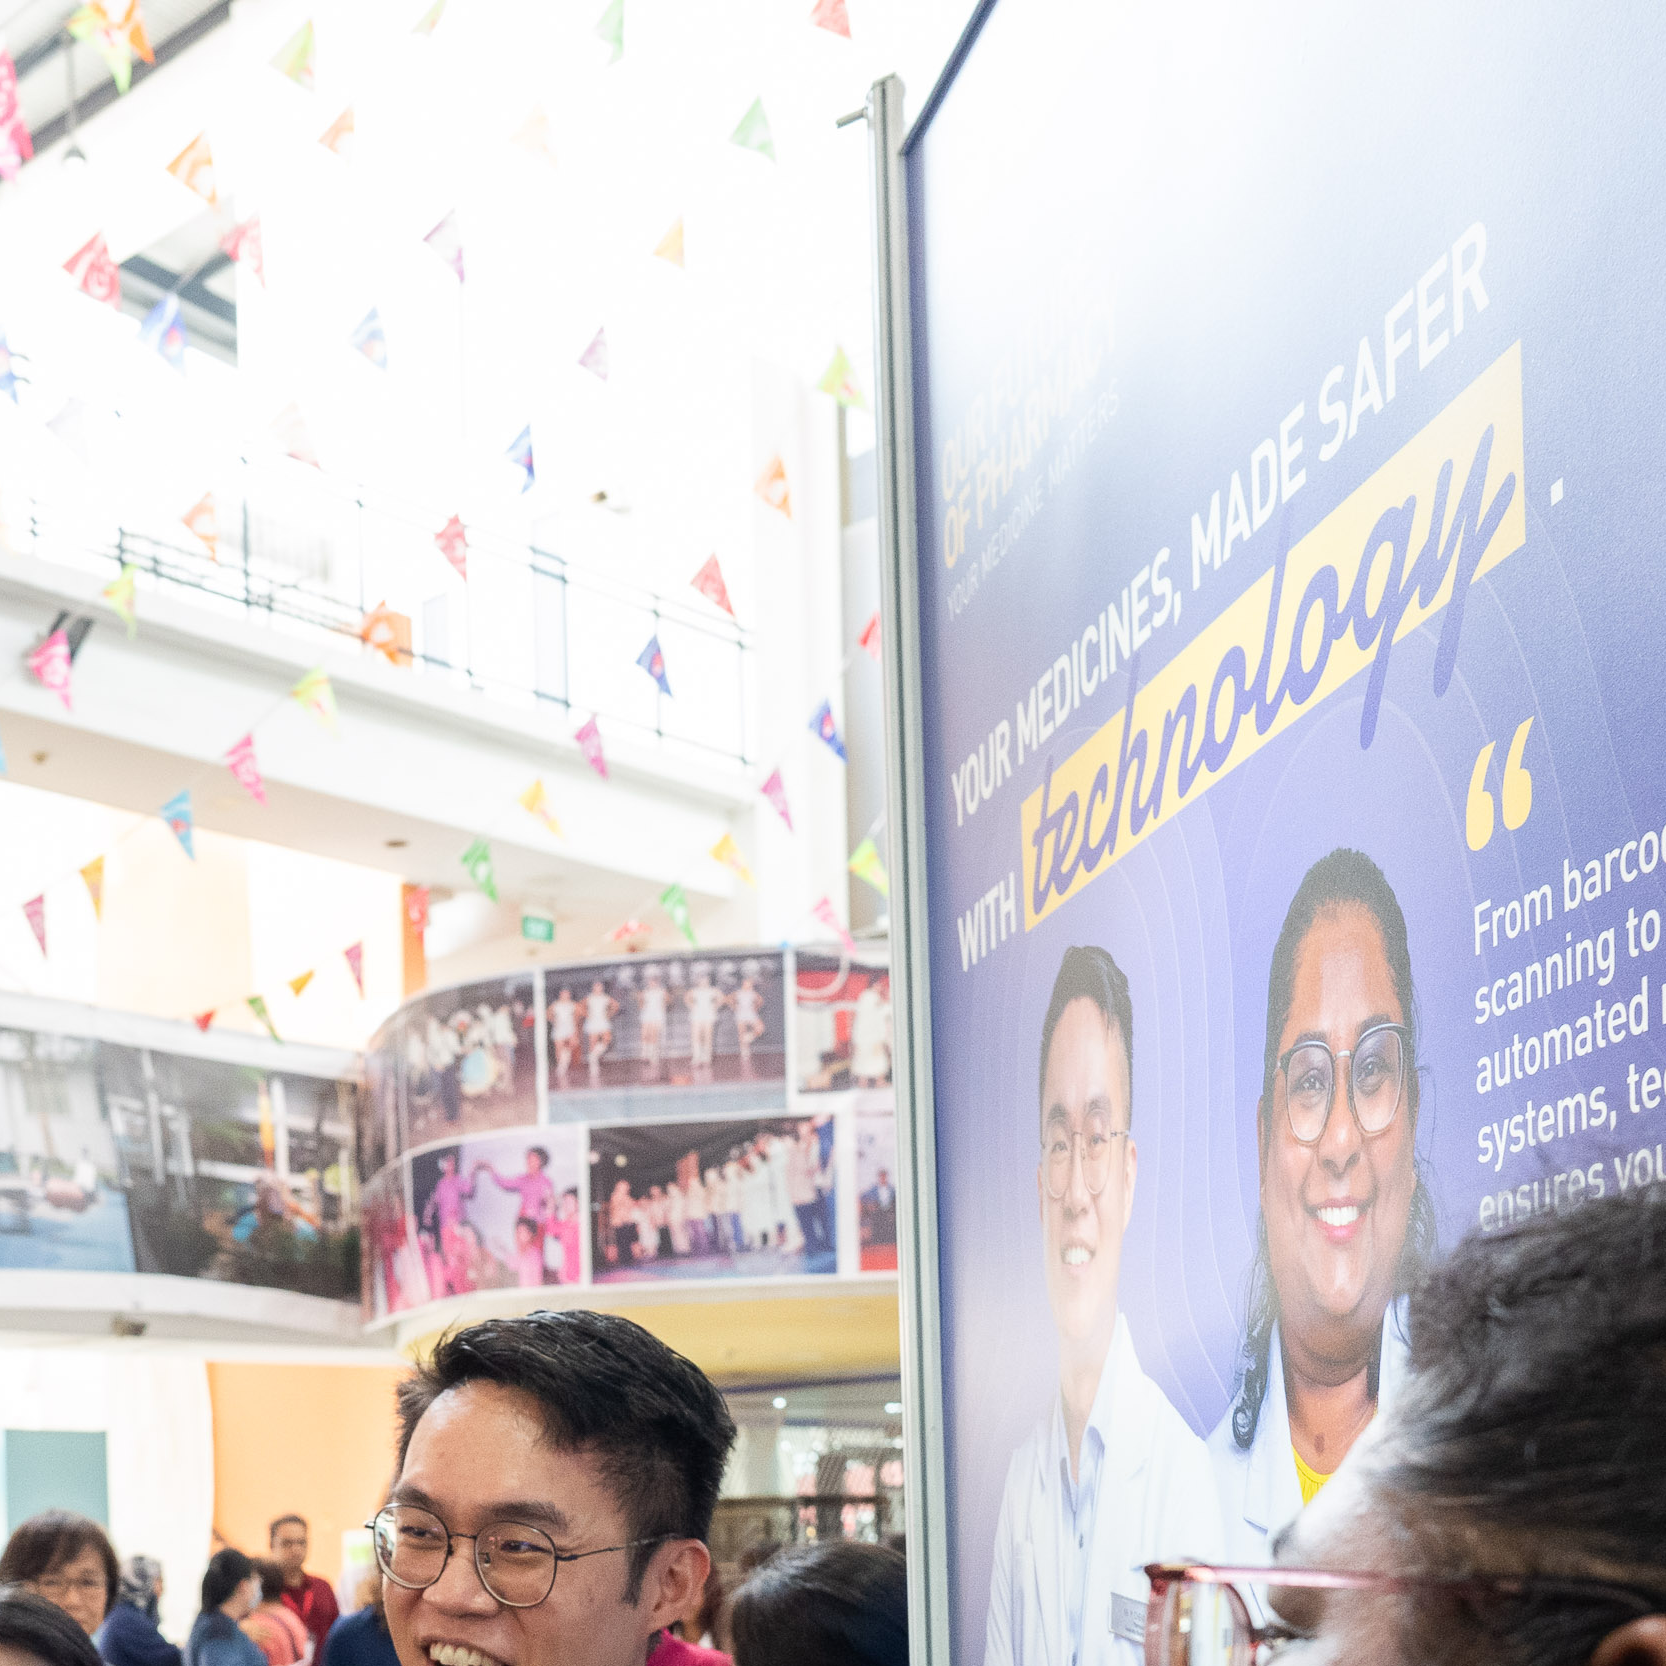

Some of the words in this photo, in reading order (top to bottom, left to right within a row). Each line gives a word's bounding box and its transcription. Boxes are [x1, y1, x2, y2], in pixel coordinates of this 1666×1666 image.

[942, 393, 988, 501] OUR
[946, 560, 979, 622] YOUR
[981, 474, 1045, 580] MEDICINE
[1047, 376, 1121, 495] MATTERS
[944, 482, 971, 569] OF
[951, 719, 1012, 828] YOUR
[1016, 545, 1182, 766] MEDICINES,
[1191, 401, 1307, 591] MADE
[1317, 220, 1491, 463] SAFER
[956, 872, 1017, 973] WITH
[1474, 883, 1553, 956] From
[1474, 925, 1616, 1025] scanning
[1625, 907, 1662, 958] to
[1475, 975, 1649, 1095] automated
[1477, 1084, 1618, 1172] systems,
[1479, 1159, 1606, 1233] ensures
